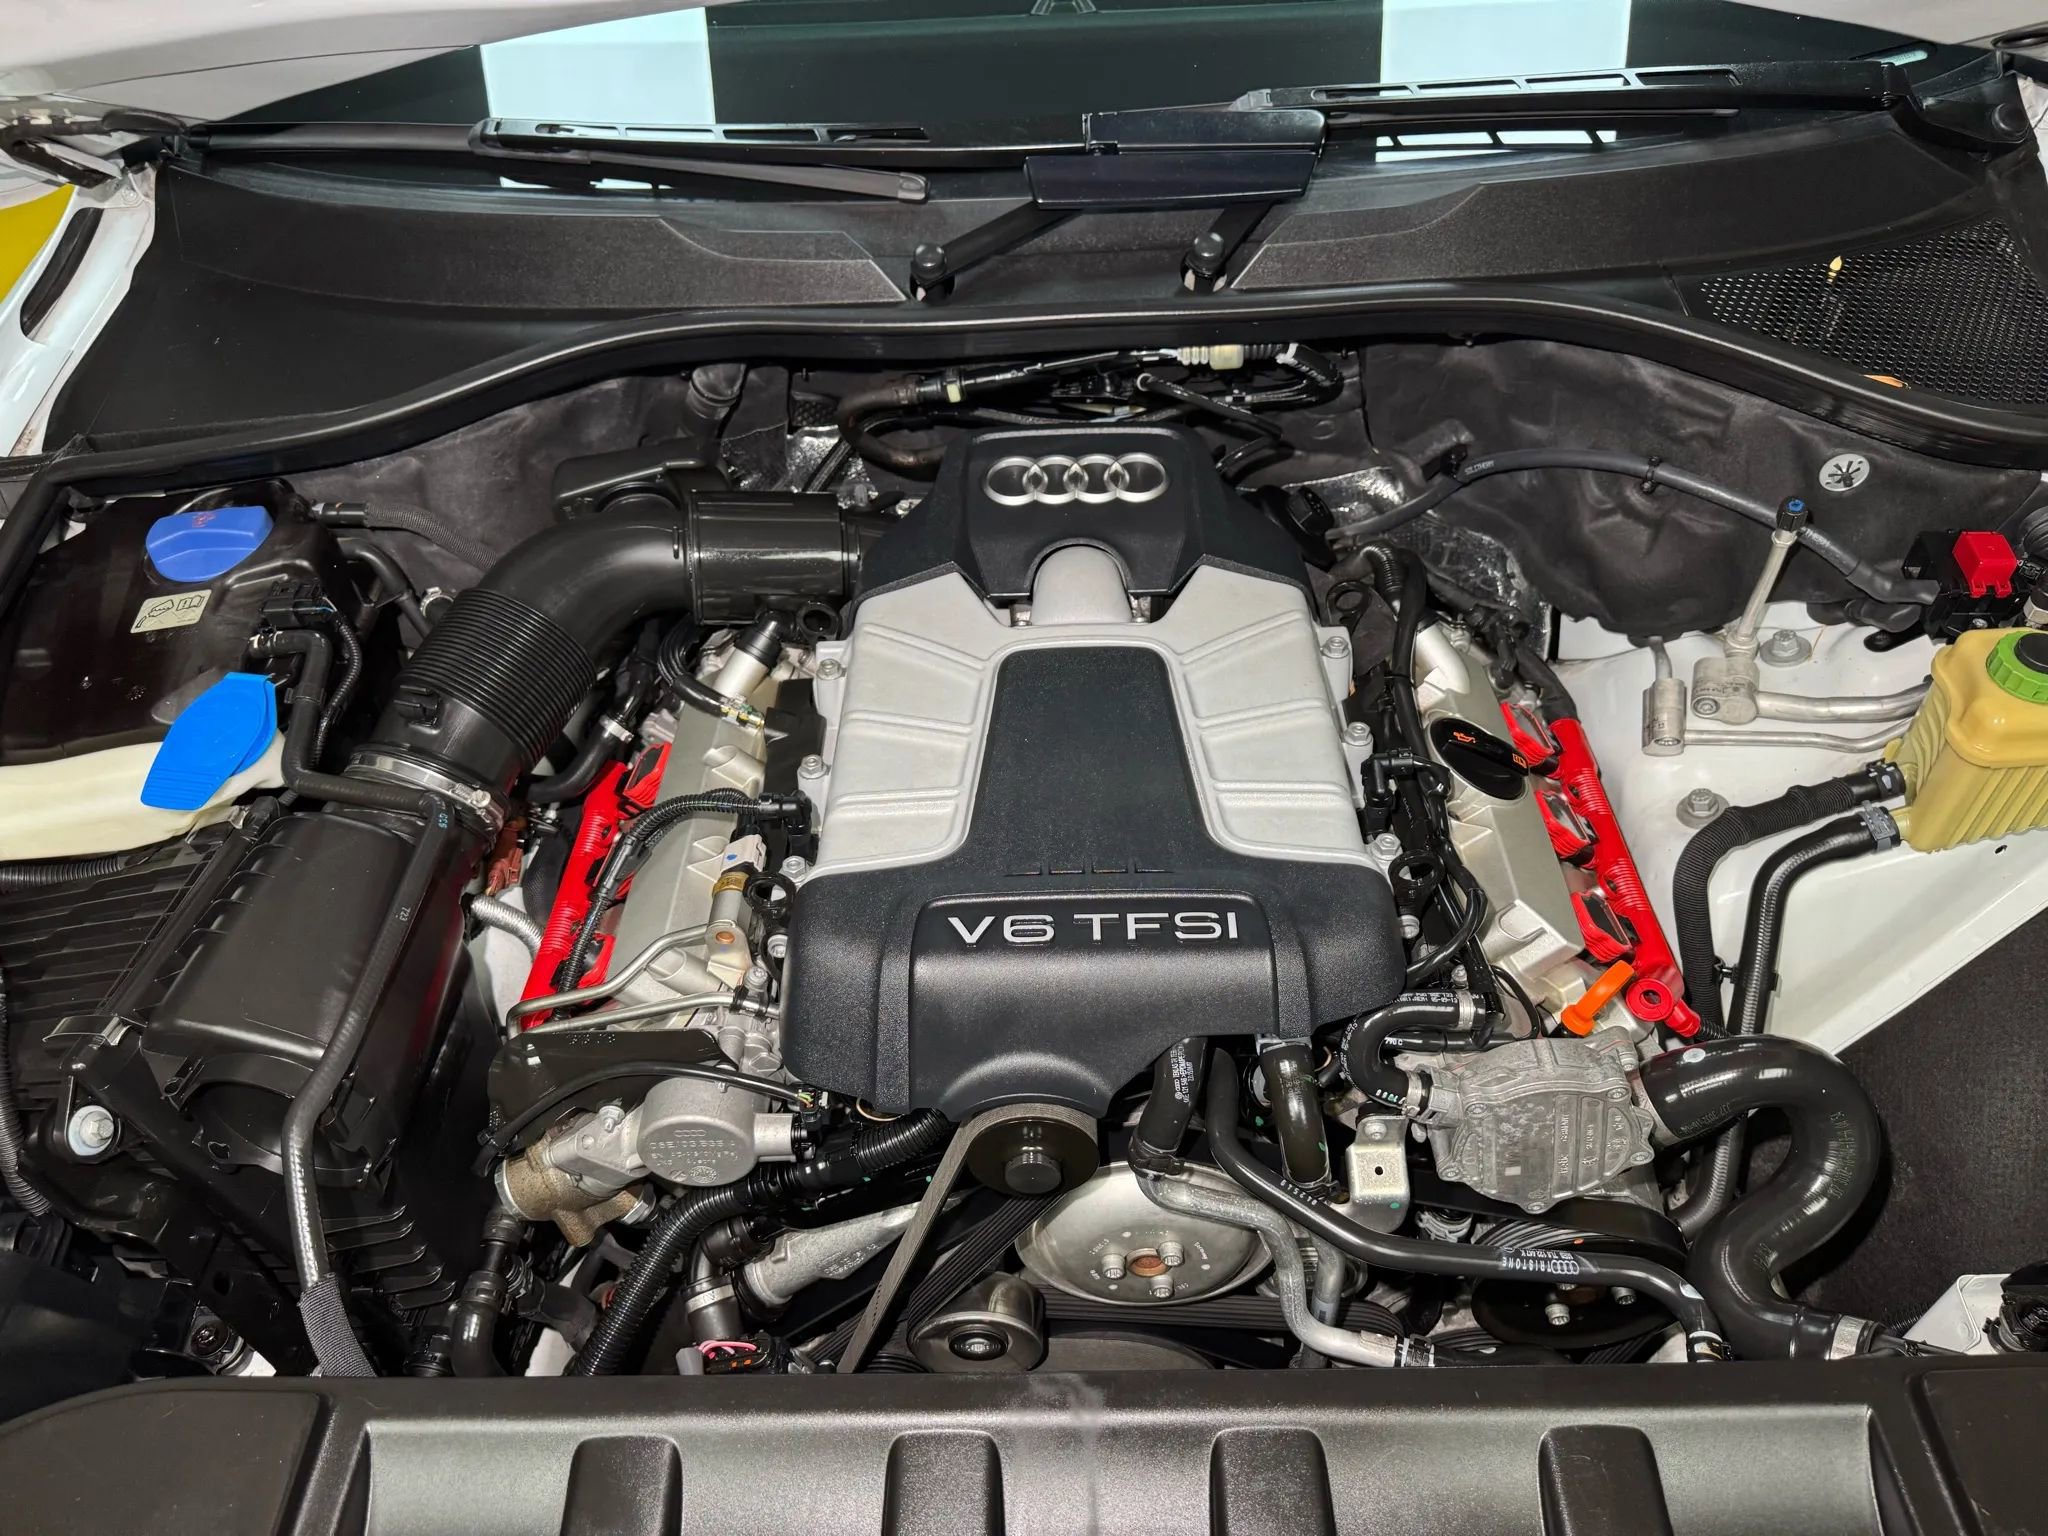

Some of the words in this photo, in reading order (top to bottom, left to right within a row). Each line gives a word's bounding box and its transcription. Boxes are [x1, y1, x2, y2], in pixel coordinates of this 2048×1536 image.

[948, 912, 1055, 945] V6
[1073, 911, 1239, 944] TFSI
[1502, 1256, 1552, 1273] TRISTONE
